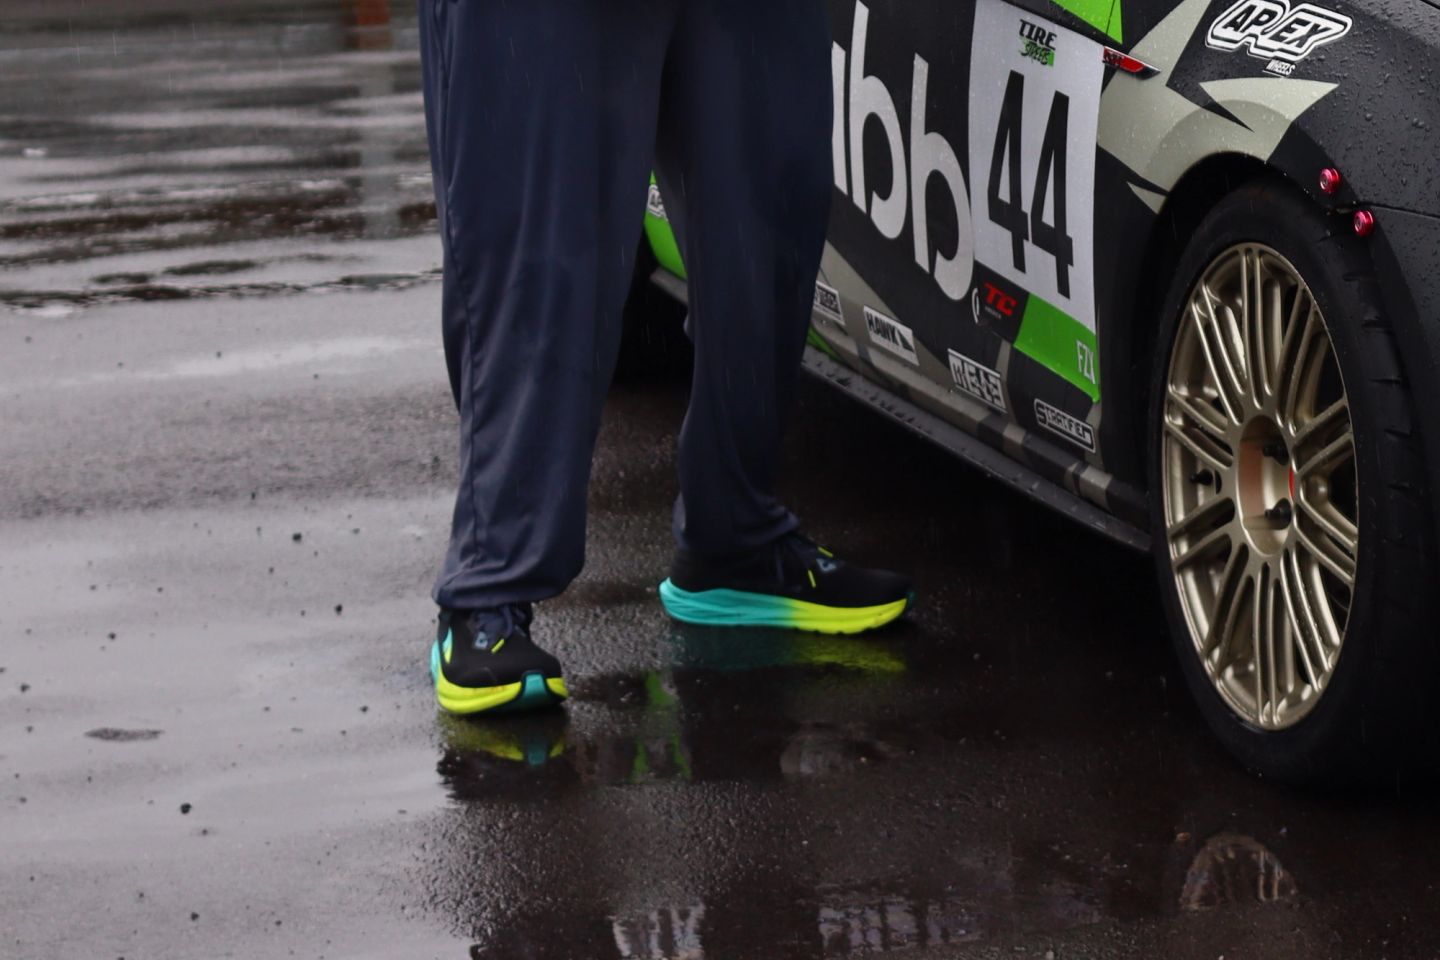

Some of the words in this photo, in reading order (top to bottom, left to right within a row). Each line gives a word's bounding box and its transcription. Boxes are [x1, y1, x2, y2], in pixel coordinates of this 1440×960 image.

[1019, 19, 1057, 51] TIRE
[1219, 1, 1335, 50] APEX
[832, 0, 974, 301] bb
[987, 70, 1074, 301] 44
